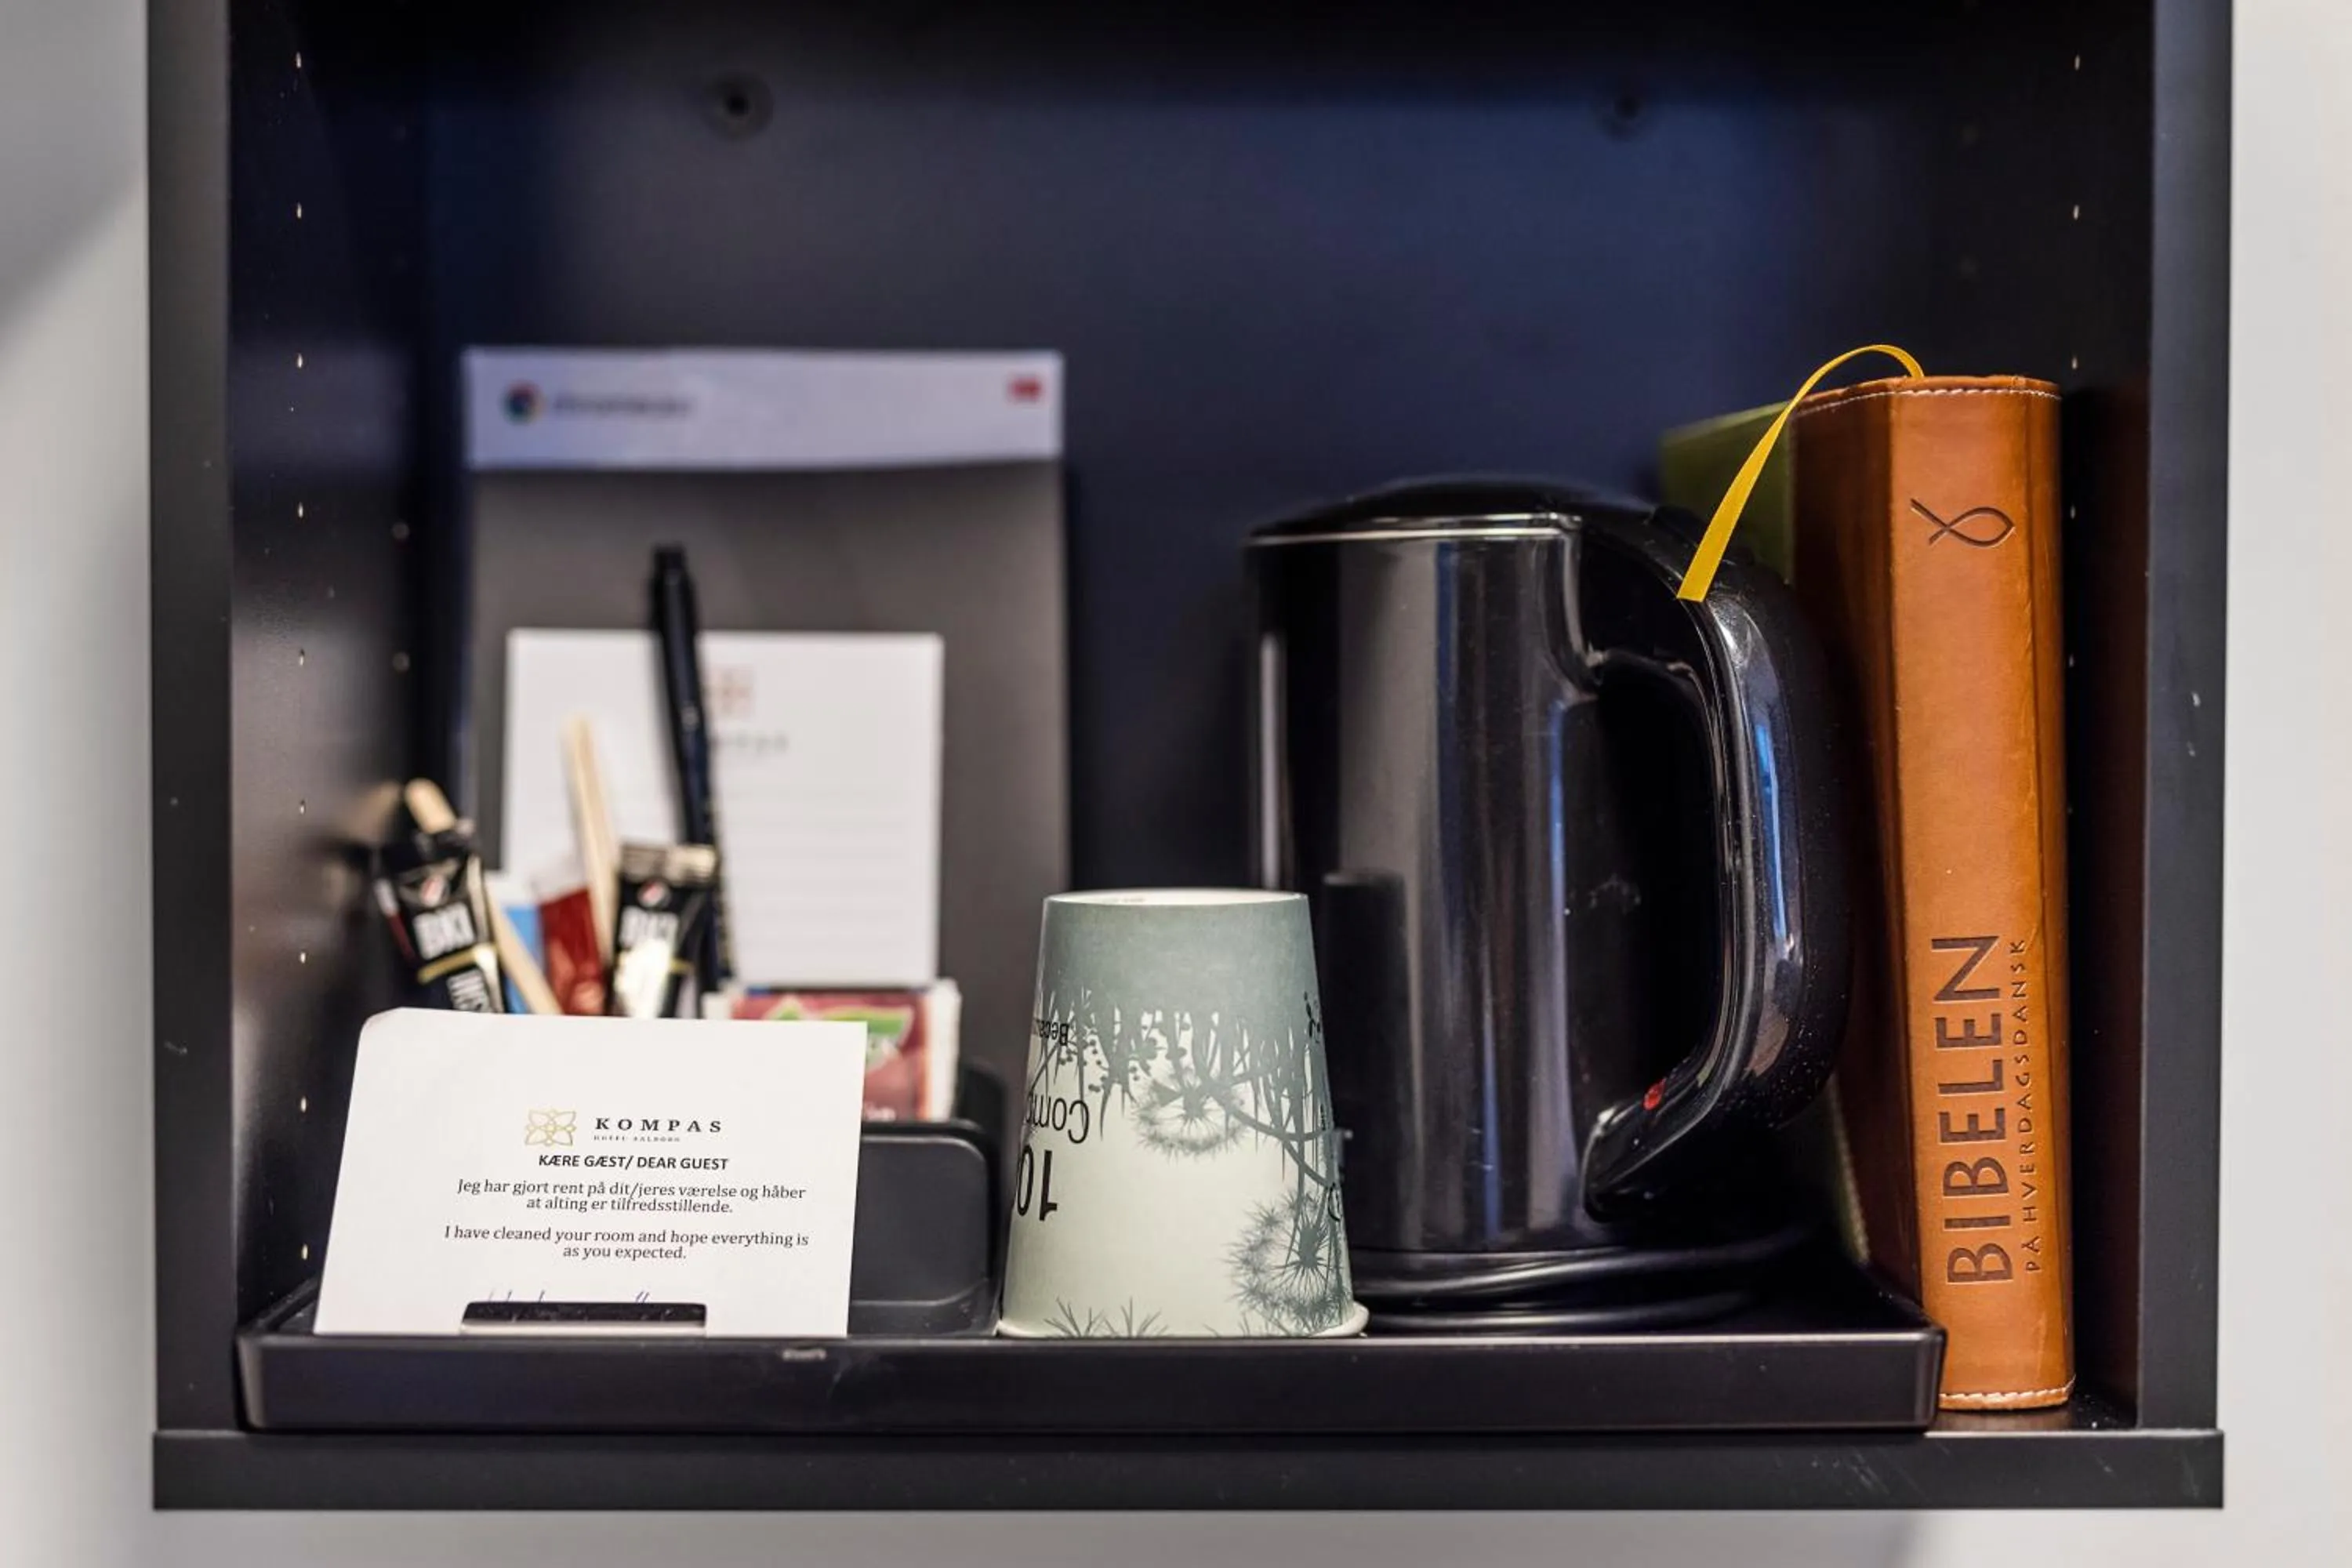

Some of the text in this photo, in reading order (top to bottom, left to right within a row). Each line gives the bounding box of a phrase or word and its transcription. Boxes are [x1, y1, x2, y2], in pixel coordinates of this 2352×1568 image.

[1932, 935, 2013, 1283] BIBELEN
[2009, 939, 2042, 1272] PÅ HVERDAGSDANSK
[595, 1117, 722, 1133] KOMPAS
[539, 1154, 729, 1171] KÆRE GÆST/ DEAR GUEST
[457, 1178, 807, 1202] Jeg har gjort rent på dit/jeres værelse og håber
[526, 1196, 733, 1213] at alting er tilfredsstillende.
[445, 1225, 809, 1248] I have cleaned your room and hope everything is
[563, 1246, 688, 1261] as you expected.
